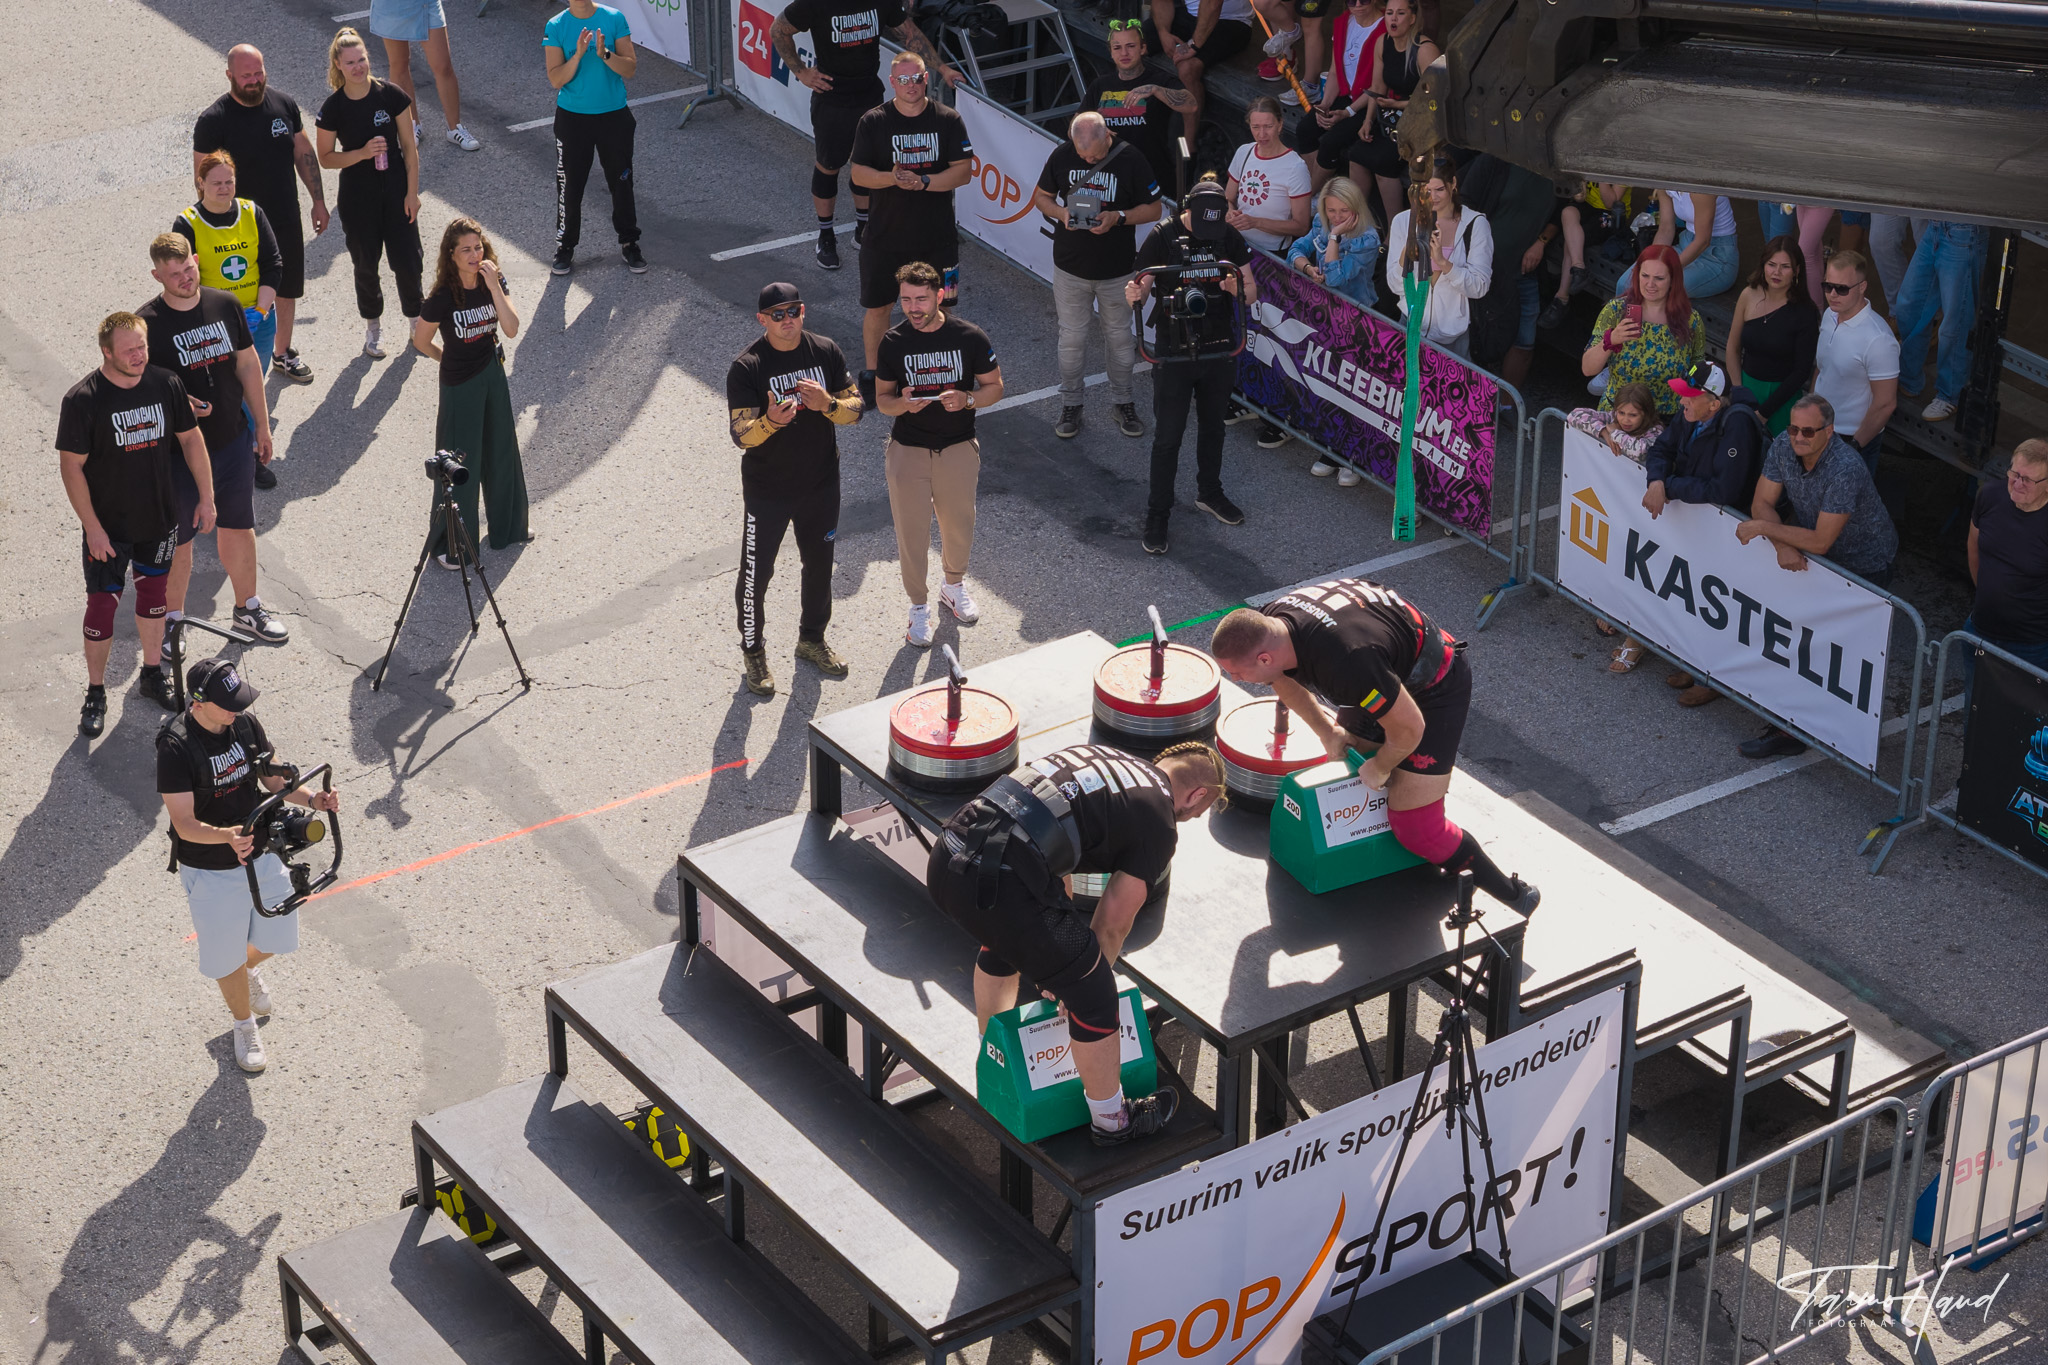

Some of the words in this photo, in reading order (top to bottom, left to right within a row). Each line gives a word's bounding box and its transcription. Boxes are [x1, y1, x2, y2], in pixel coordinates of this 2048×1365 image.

[742, 21, 768, 60] 24
[1104, 116, 1147, 126] THUANIA
[214, 242, 249, 254] MEDIC
[904, 349, 962, 376] STRONGMAN
[1381, 420, 1460, 476] RELAAM
[744, 512, 756, 598] ARMLIFTING
[743, 598, 756, 649] ESTONIA
[1624, 528, 1873, 714] KASTELLI
[1333, 804, 1361, 822] POP
[1368, 796, 1389, 812] SP
[1028, 1022, 1051, 1034] Suurim
[1036, 1045, 1065, 1064] POP
[1120, 1176, 1243, 1241] Suurim
[1255, 1138, 1329, 1191] valik
[1126, 1276, 1282, 1365] POP
[1330, 1127, 1586, 1298] SPORT!
